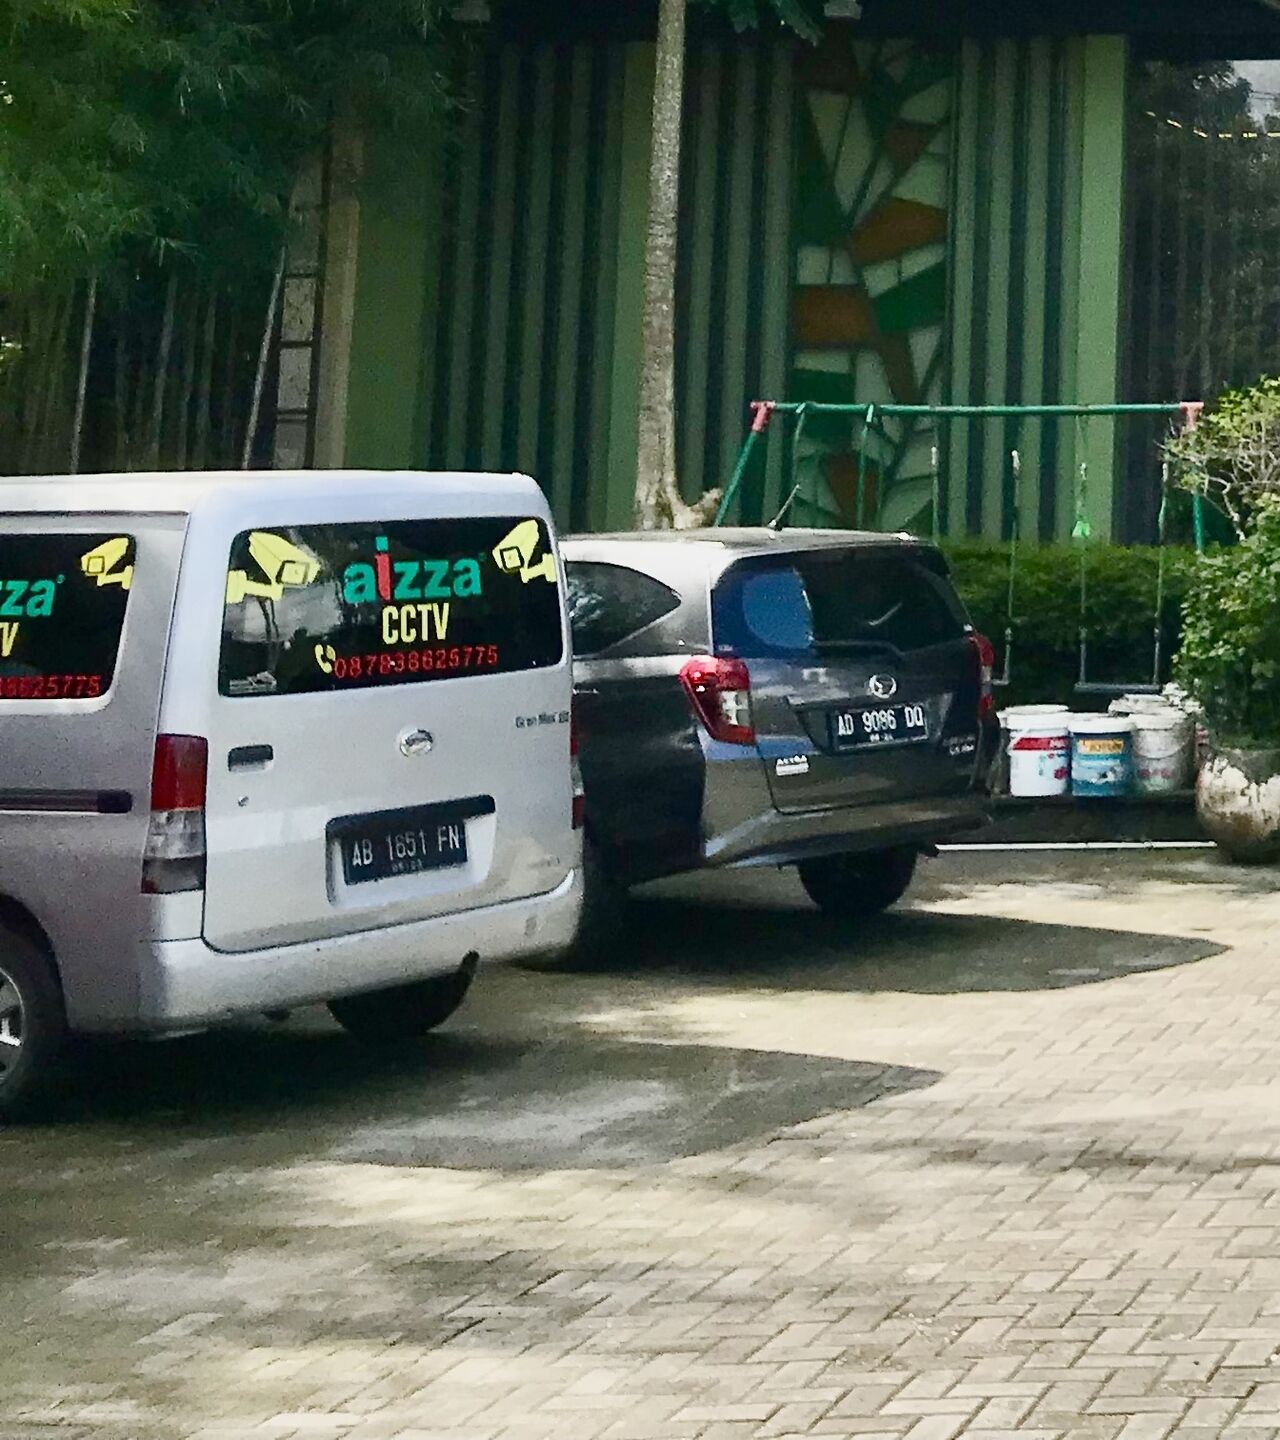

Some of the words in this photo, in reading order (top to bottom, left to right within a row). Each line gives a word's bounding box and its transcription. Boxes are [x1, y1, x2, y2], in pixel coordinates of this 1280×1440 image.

[343, 536, 482, 604] aizza
[0, 579, 56, 618] za
[382, 603, 450, 645] CCTV
[837, 714, 854, 736] AD
[352, 838, 373, 867] AB
[385, 828, 427, 862] 1651
[437, 825, 460, 853] FN
